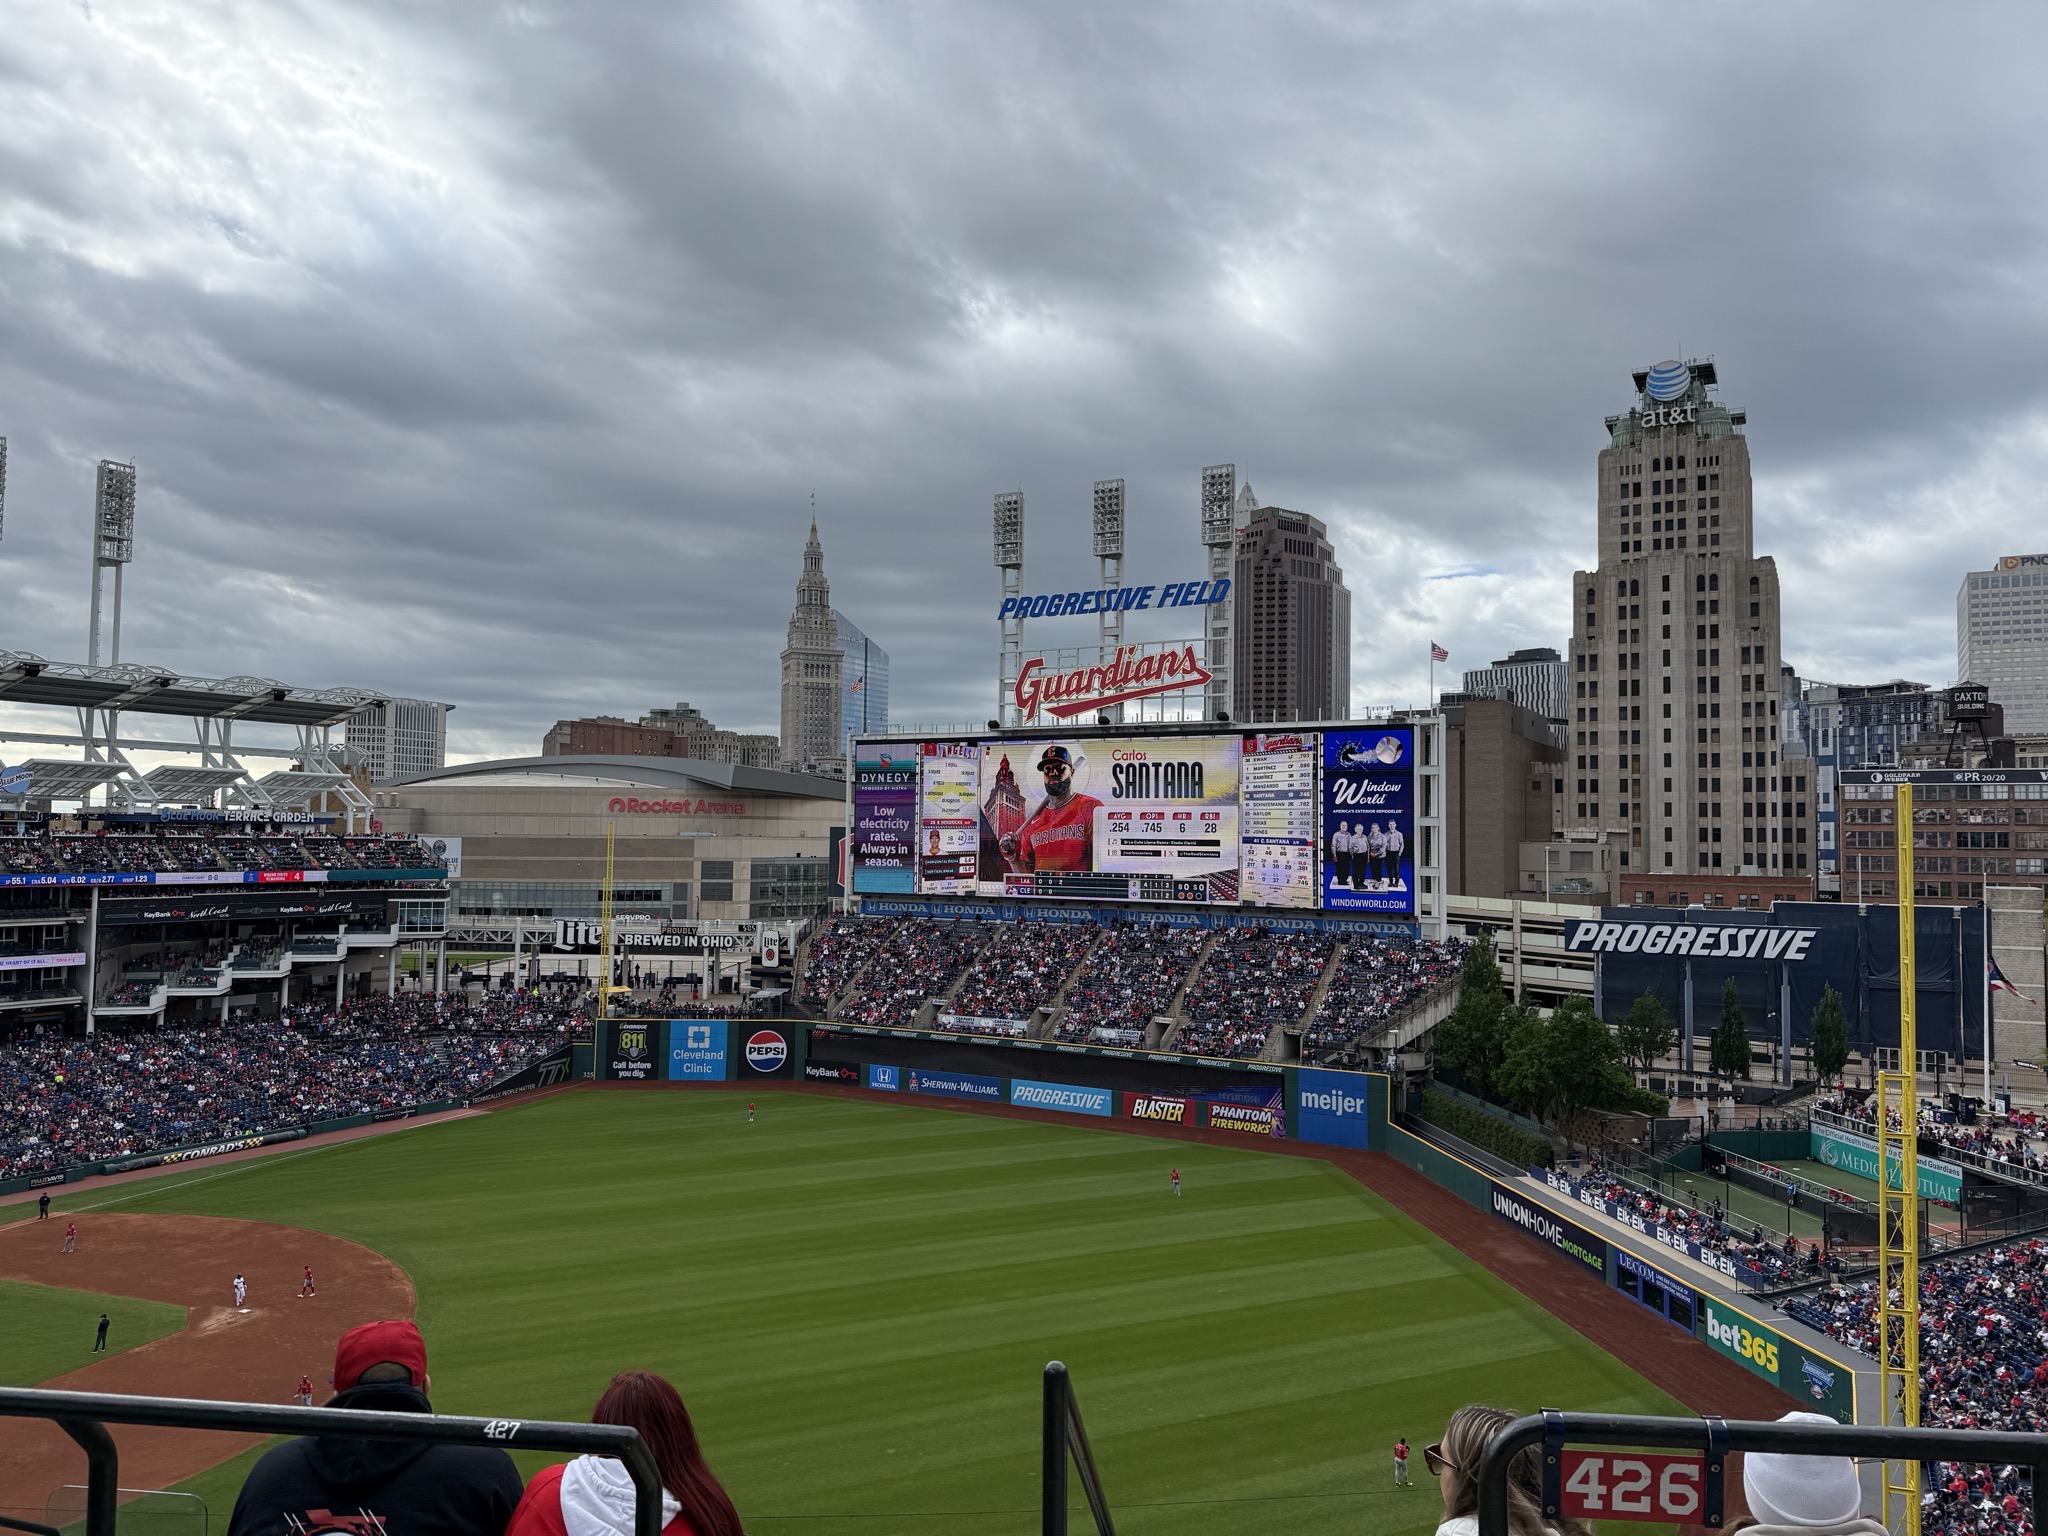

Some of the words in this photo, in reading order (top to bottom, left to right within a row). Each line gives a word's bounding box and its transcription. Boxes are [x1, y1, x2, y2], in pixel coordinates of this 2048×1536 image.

[1641, 401, 1697, 428] at&t
[998, 585, 1155, 620] PROGRESSIVE
[1157, 579, 1232, 608] FIELD
[1014, 645, 1213, 724] Guardians
[1264, 735, 1302, 751] Guardians
[1048, 747, 1056, 757] C
[1112, 749, 1146, 761] Carlos
[16, 773, 33, 781] MOON
[861, 773, 909, 783] DYNEGY
[1112, 762, 1204, 798] SANTANA
[1964, 772, 1980, 781] PR
[627, 798, 690, 814] Rocket
[694, 800, 745, 814] Arena
[874, 806, 896, 816] Low
[160, 808, 188, 822] BLUE
[190, 811, 219, 821] MOON
[224, 810, 270, 822] TERRACE
[272, 812, 314, 822] GARDEN
[860, 819, 909, 831] electricity
[1110, 823, 1129, 832] .254
[1142, 823, 1162, 832] .745
[1180, 823, 1186, 833] 6
[1205, 823, 1217, 833] 28
[870, 832, 898, 842] rates.
[860, 843, 896, 856] Always
[898, 843, 908, 854] in
[865, 858, 903, 866] season.
[878, 902, 928, 913] HONDA
[1331, 898, 1406, 909] WINDOWWORLD.COM
[944, 905, 996, 915] HONDA
[1036, 909, 1092, 919] HONDA
[1140, 913, 1201, 924] HONDA
[1250, 917, 1315, 931] HONDA
[1340, 922, 1412, 934] HONDA
[553, 919, 602, 950] Lite
[624, 934, 680, 946] BREWED
[685, 935, 698, 947] IN
[702, 936, 732, 948] OHIO
[764, 937, 778, 948] Lite
[1568, 922, 1816, 960] PROGRESSIVE
[621, 1032, 644, 1049] 811
[673, 1050, 723, 1060] Cleveland
[748, 1046, 784, 1056] PEPSI
[1056, 1045, 1087, 1053] PROGRESSIVE
[1148, 1054, 1181, 1062] PROGRESSIVE
[1196, 1058, 1232, 1068] PROGRESSIVE
[632, 1070, 645, 1078] dig.
[683, 1063, 712, 1074] Clinic
[806, 1066, 839, 1078] KeyBank
[1247, 1064, 1283, 1073] PROGRESSIVE
[502, 1088, 518, 1096] PEOPLE
[519, 1084, 535, 1093] MATTER
[1013, 1086, 1104, 1109] PROGRESSIVE
[1302, 1090, 1364, 1116] meijer
[1133, 1099, 1184, 1122] BLASTER
[1212, 1105, 1272, 1122] PHANTOM
[1210, 1118, 1271, 1134] FIREWORKS
[182, 1141, 245, 1161] CONRAD'S
[1825, 1129, 1844, 1141] Official
[1845, 1136, 1861, 1146] Health
[1862, 1142, 1879, 1151] Insure
[1928, 1161, 1960, 1176] Guardians
[1562, 1238, 1602, 1270] MORTGAGE
[1619, 1253, 1655, 1282] LECOM
[1707, 1308, 1778, 1373] bet365
[1805, 1365, 1831, 1382] PROGRESSIVE
[1840, 1409, 1852, 1423] 375
[483, 1421, 521, 1439] 427
[1565, 1457, 1698, 1515] 426
